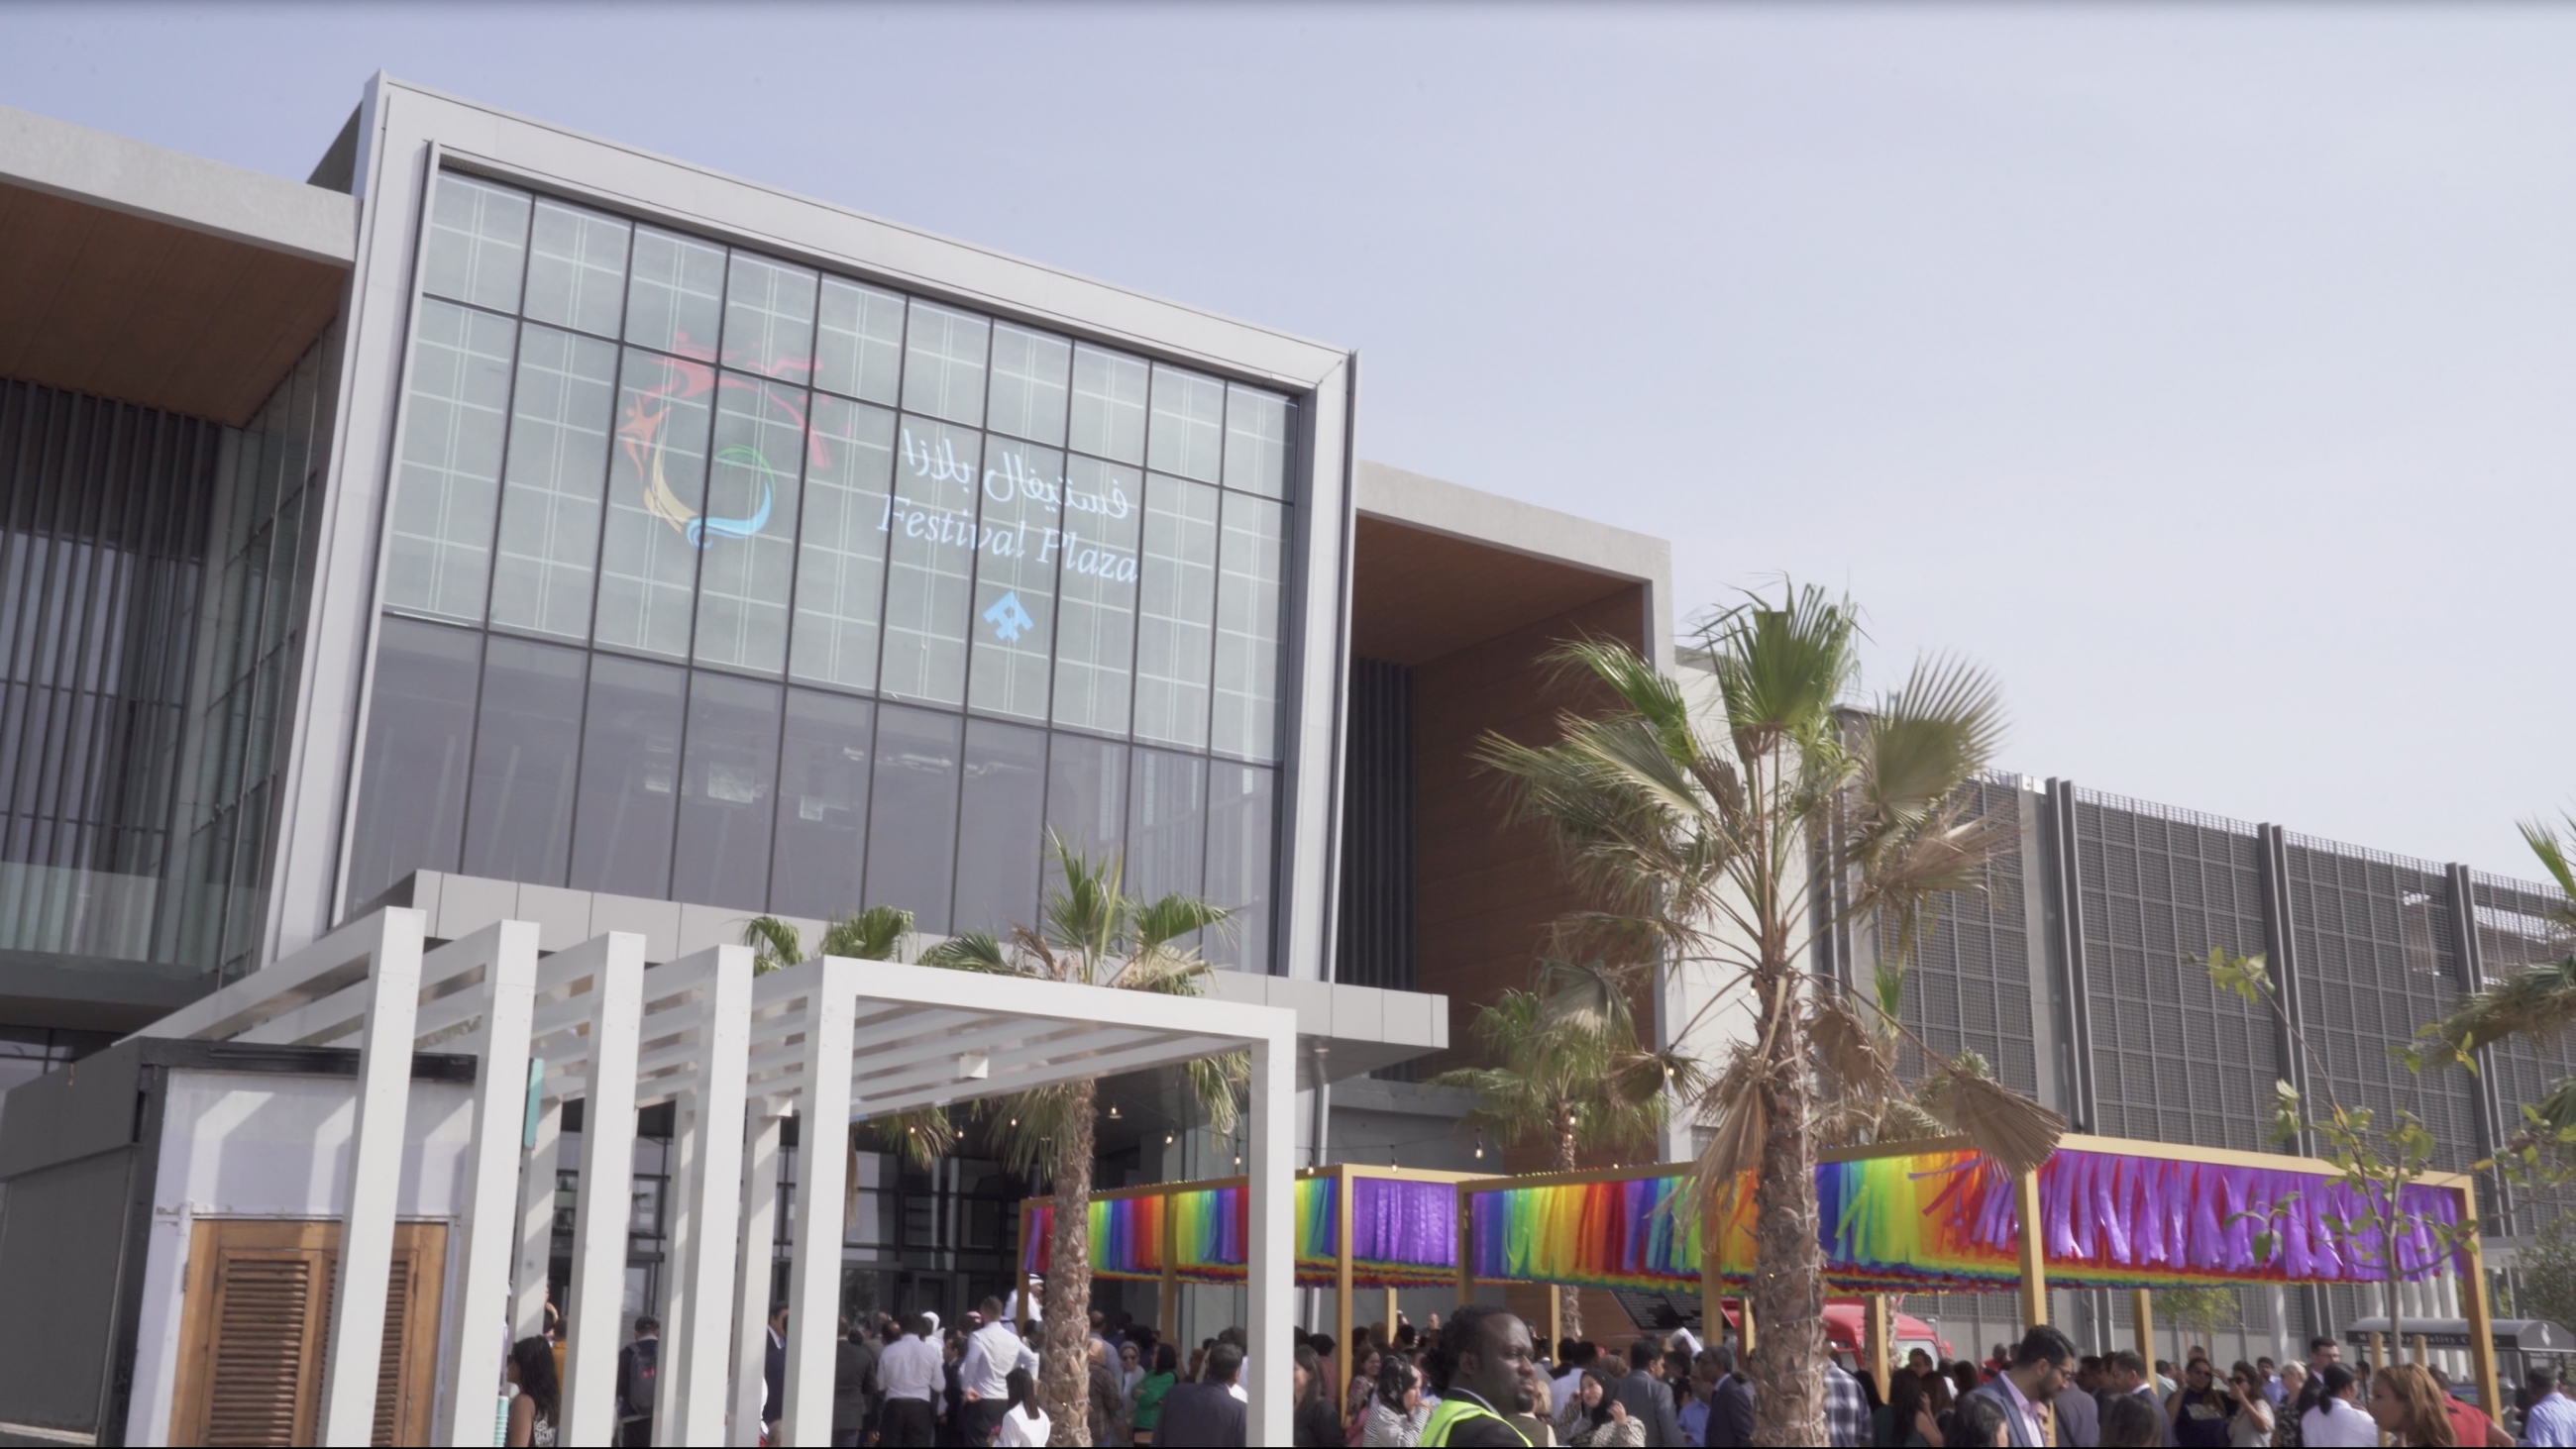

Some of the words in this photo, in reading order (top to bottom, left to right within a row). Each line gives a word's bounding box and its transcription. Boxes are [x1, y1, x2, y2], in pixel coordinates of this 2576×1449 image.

[903, 428, 971, 493] بلازا
[984, 451, 1128, 519] فستيفال
[877, 493, 1025, 559] Festival
[1036, 526, 1139, 583] Plaza
